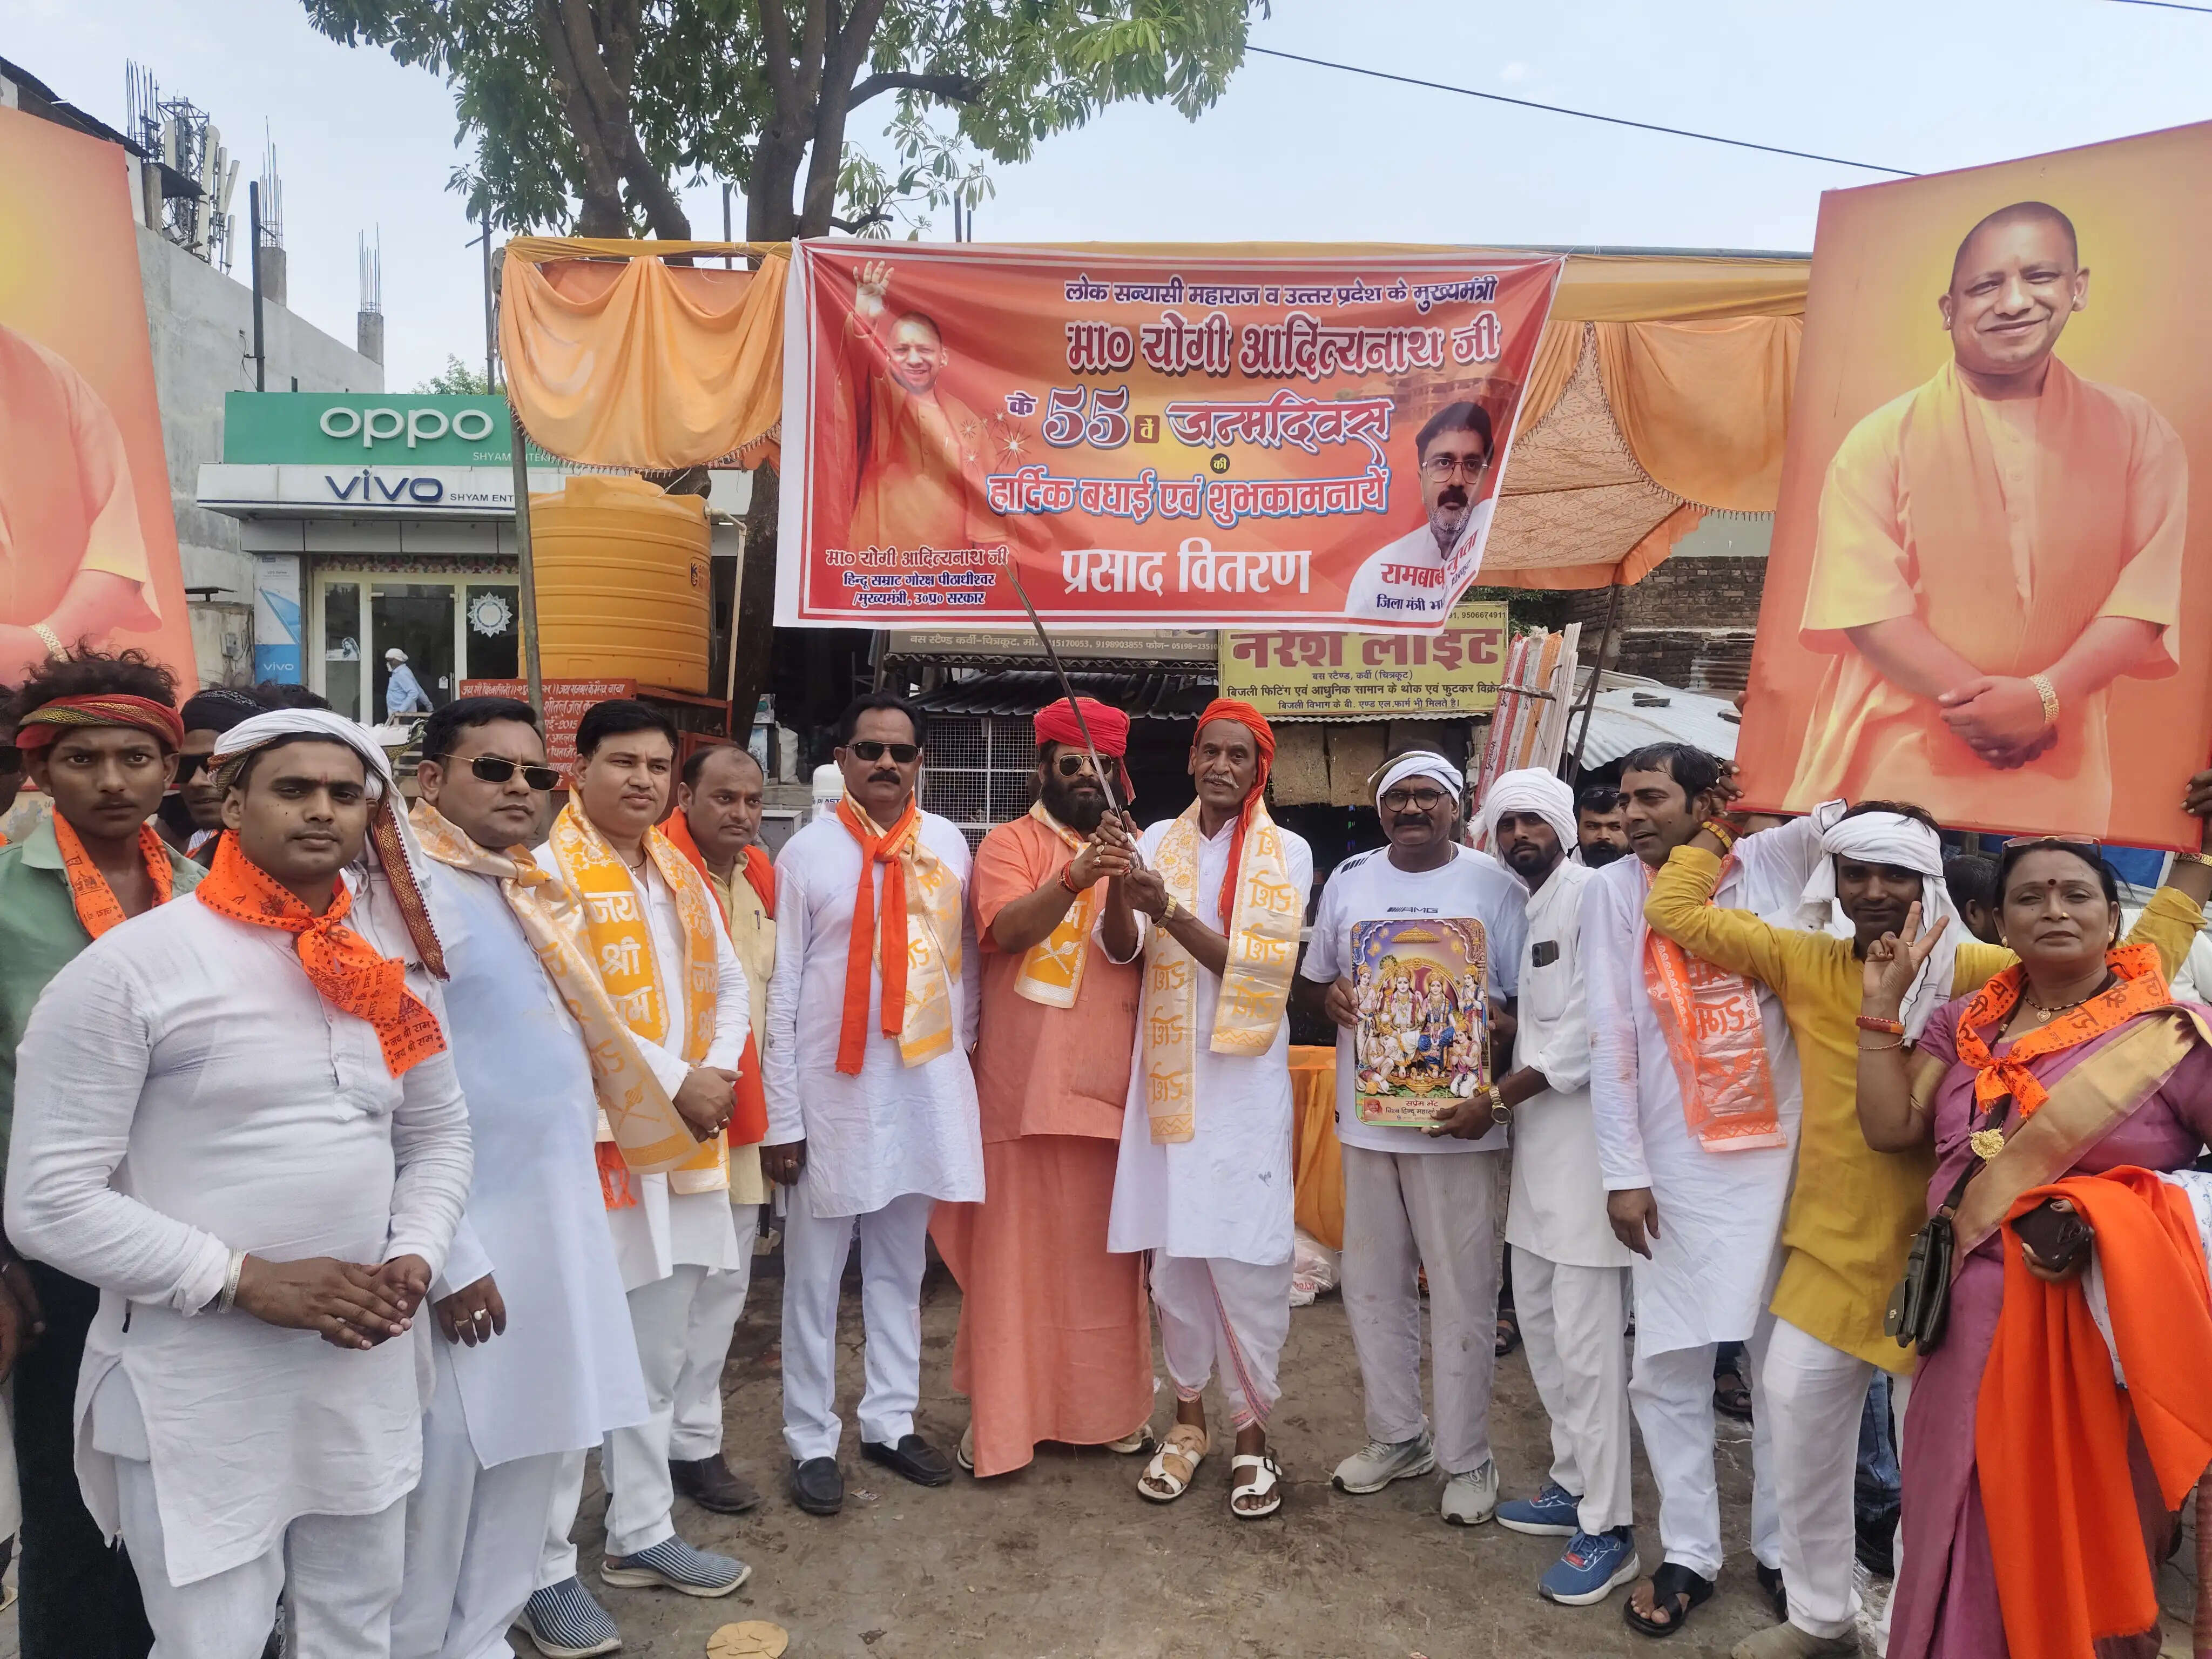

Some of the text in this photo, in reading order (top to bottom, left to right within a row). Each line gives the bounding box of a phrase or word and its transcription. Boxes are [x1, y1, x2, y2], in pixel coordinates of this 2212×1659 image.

[1064, 274, 1499, 315] लोक सन्यासी महाराज व उत्तर प्रदेश के मुख्यमंत्री
[1066, 310, 1501, 380] मा० योगी आदित्यनाथ जी
[320, 407, 494, 449] oppo
[1004, 390, 1038, 417] के
[1042, 384, 1131, 449] 55
[1165, 388, 1395, 466] जन्मदिवस
[473, 452, 512, 461] SHYAM
[1213, 457, 1228, 470] की
[325, 469, 444, 503] vivo
[986, 465, 1391, 529] हार्दिक बधाई एवं शुभकामनायें
[826, 545, 1009, 567] मा० योगी आदित्यनाथ जी
[1062, 538, 1311, 597] प्रसाद वितरण
[843, 570, 996, 591] हिन्दू सम्राट गोरक्ष पीठाधीश्वर
[946, 591, 986, 604] सरकार
[1377, 594, 1404, 609] जिला
[1406, 597, 1425, 611] मंत्री
[1041, 638, 1092, 648] 15170053,
[1359, 629, 1503, 671] लाइट
[263, 662, 294, 670] vivo
[1355, 670, 1372, 679] कर्वी
[1227, 685, 1258, 697] बिजली
[1260, 684, 1291, 696] फिटिंग
[1294, 684, 1308, 696] एवं
[1311, 683, 1351, 698] आधुनिक
[1354, 684, 1384, 694] सामान
[1388, 683, 1397, 694] के
[1401, 682, 1422, 694] थोक
[1425, 682, 1439, 695] एवं
[1442, 684, 1473, 697] फुटकर
[1278, 699, 1304, 710] बिजली
[1306, 699, 1330, 709] विभाग
[1333, 699, 1340, 708] के
[1359, 700, 1375, 709] एण्ड
[1413, 699, 1422, 708] भी
[1425, 698, 1448, 708] मिलते
[584, 891, 643, 923] जय
[601, 936, 641, 976] श्री
[413, 1021, 430, 1033] राम
[1406, 1099, 1424, 1108] सप्रेम
